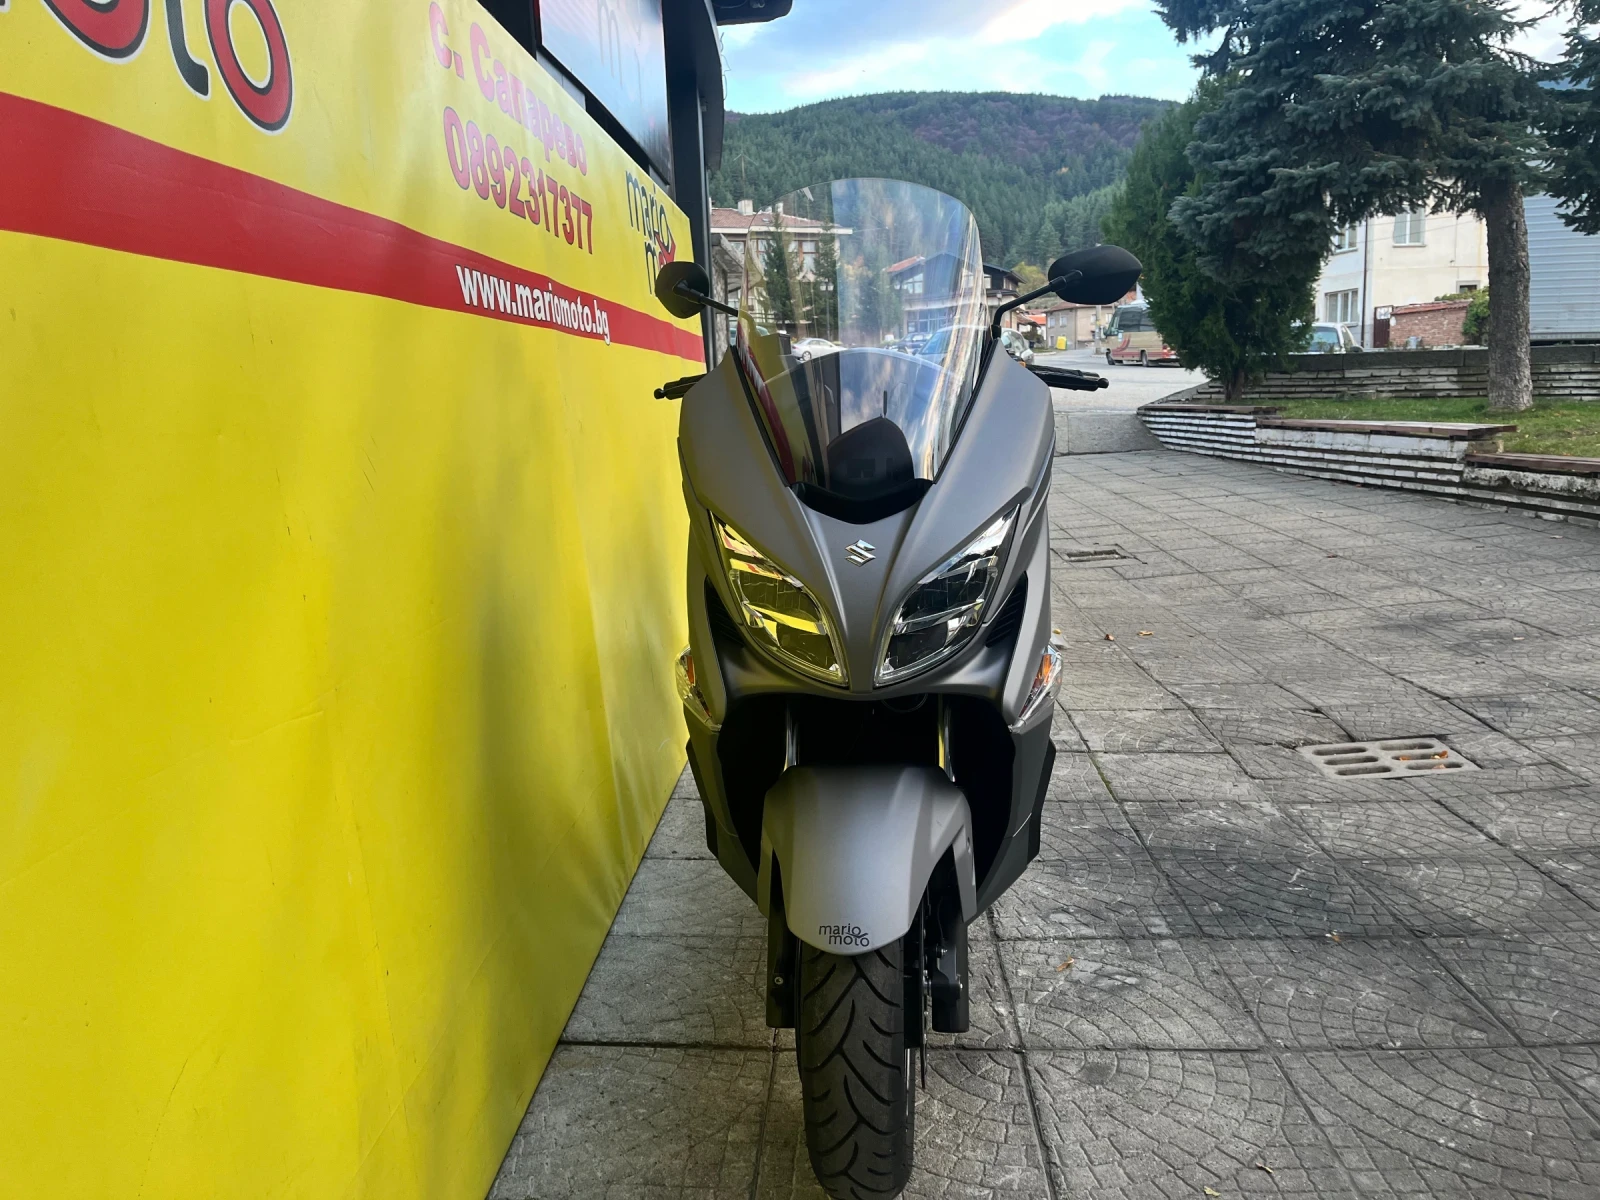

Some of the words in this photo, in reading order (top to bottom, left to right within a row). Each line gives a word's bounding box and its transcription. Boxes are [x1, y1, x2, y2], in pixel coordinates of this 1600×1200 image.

[470, 22, 588, 176] Сапарево
[443, 106, 593, 255] 0892317377
[625, 170, 672, 254] mario
[455, 265, 611, 346] www.mariomoto.bg
[818, 923, 862, 936] mario
[828, 934, 870, 947] moto
